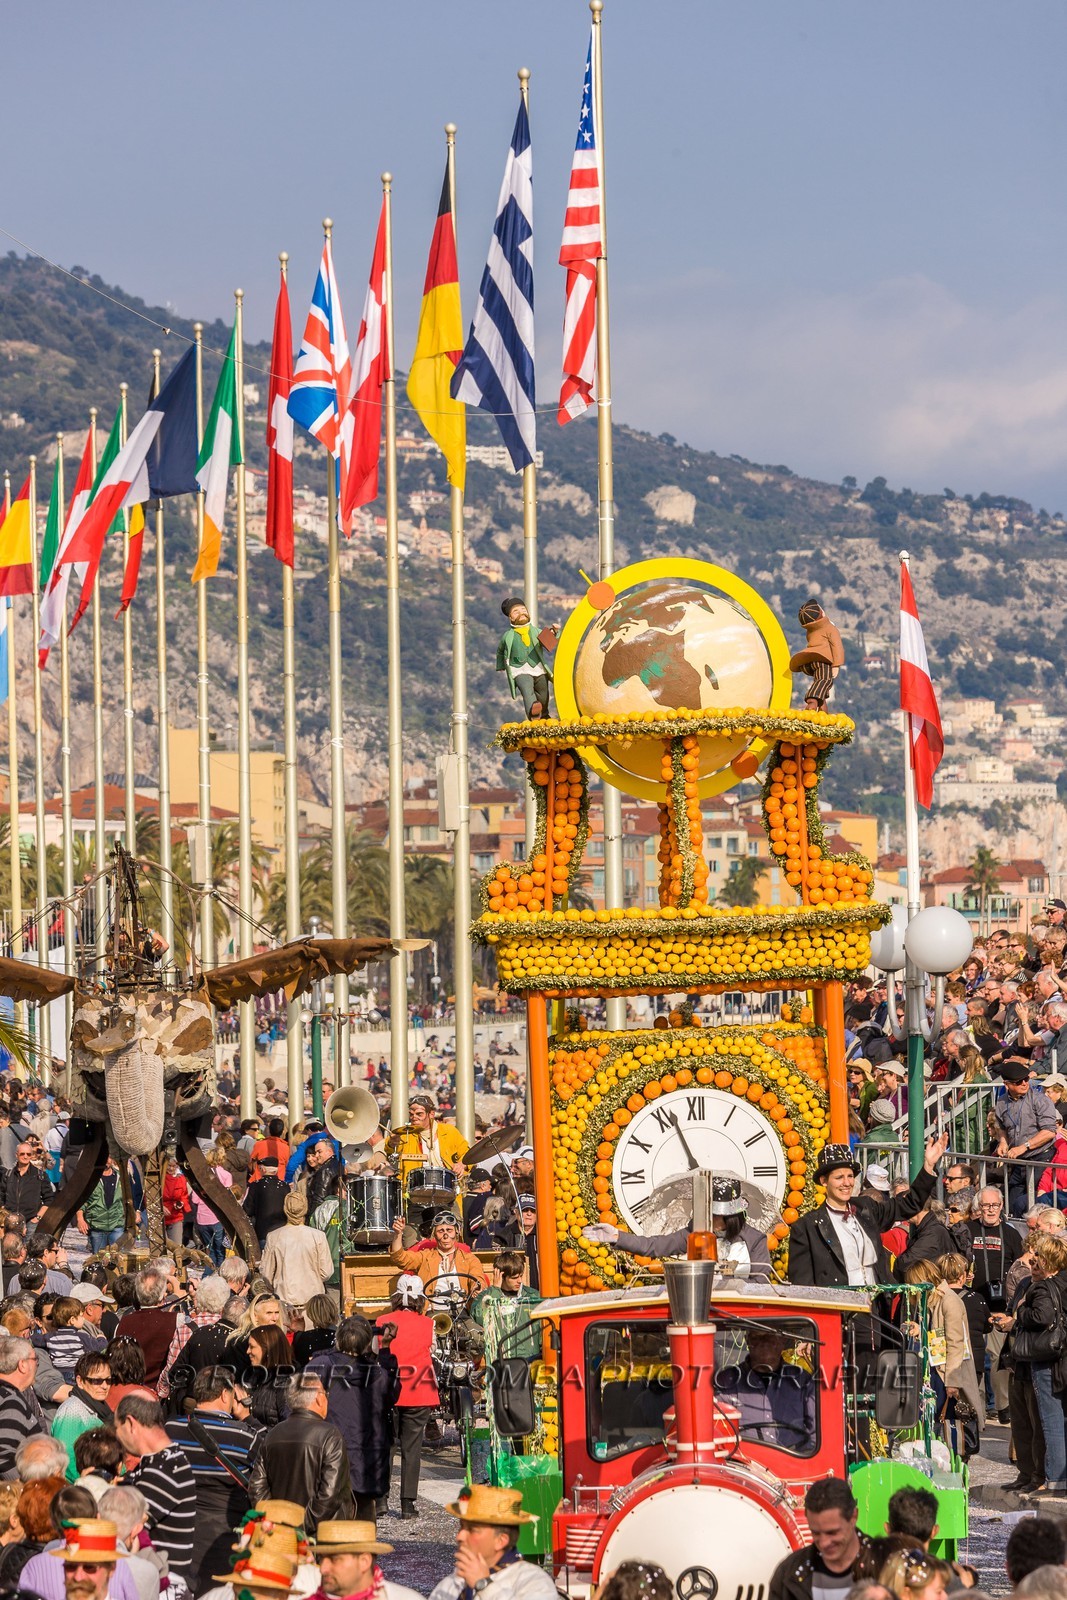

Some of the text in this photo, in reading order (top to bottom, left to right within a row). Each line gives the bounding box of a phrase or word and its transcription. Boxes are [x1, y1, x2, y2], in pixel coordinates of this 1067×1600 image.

[686, 1096, 705, 1121] XII
[650, 1106, 675, 1133] XI
[627, 1134, 653, 1154] X
[620, 1169, 646, 1185] IX
[753, 1166, 778, 1177] III
